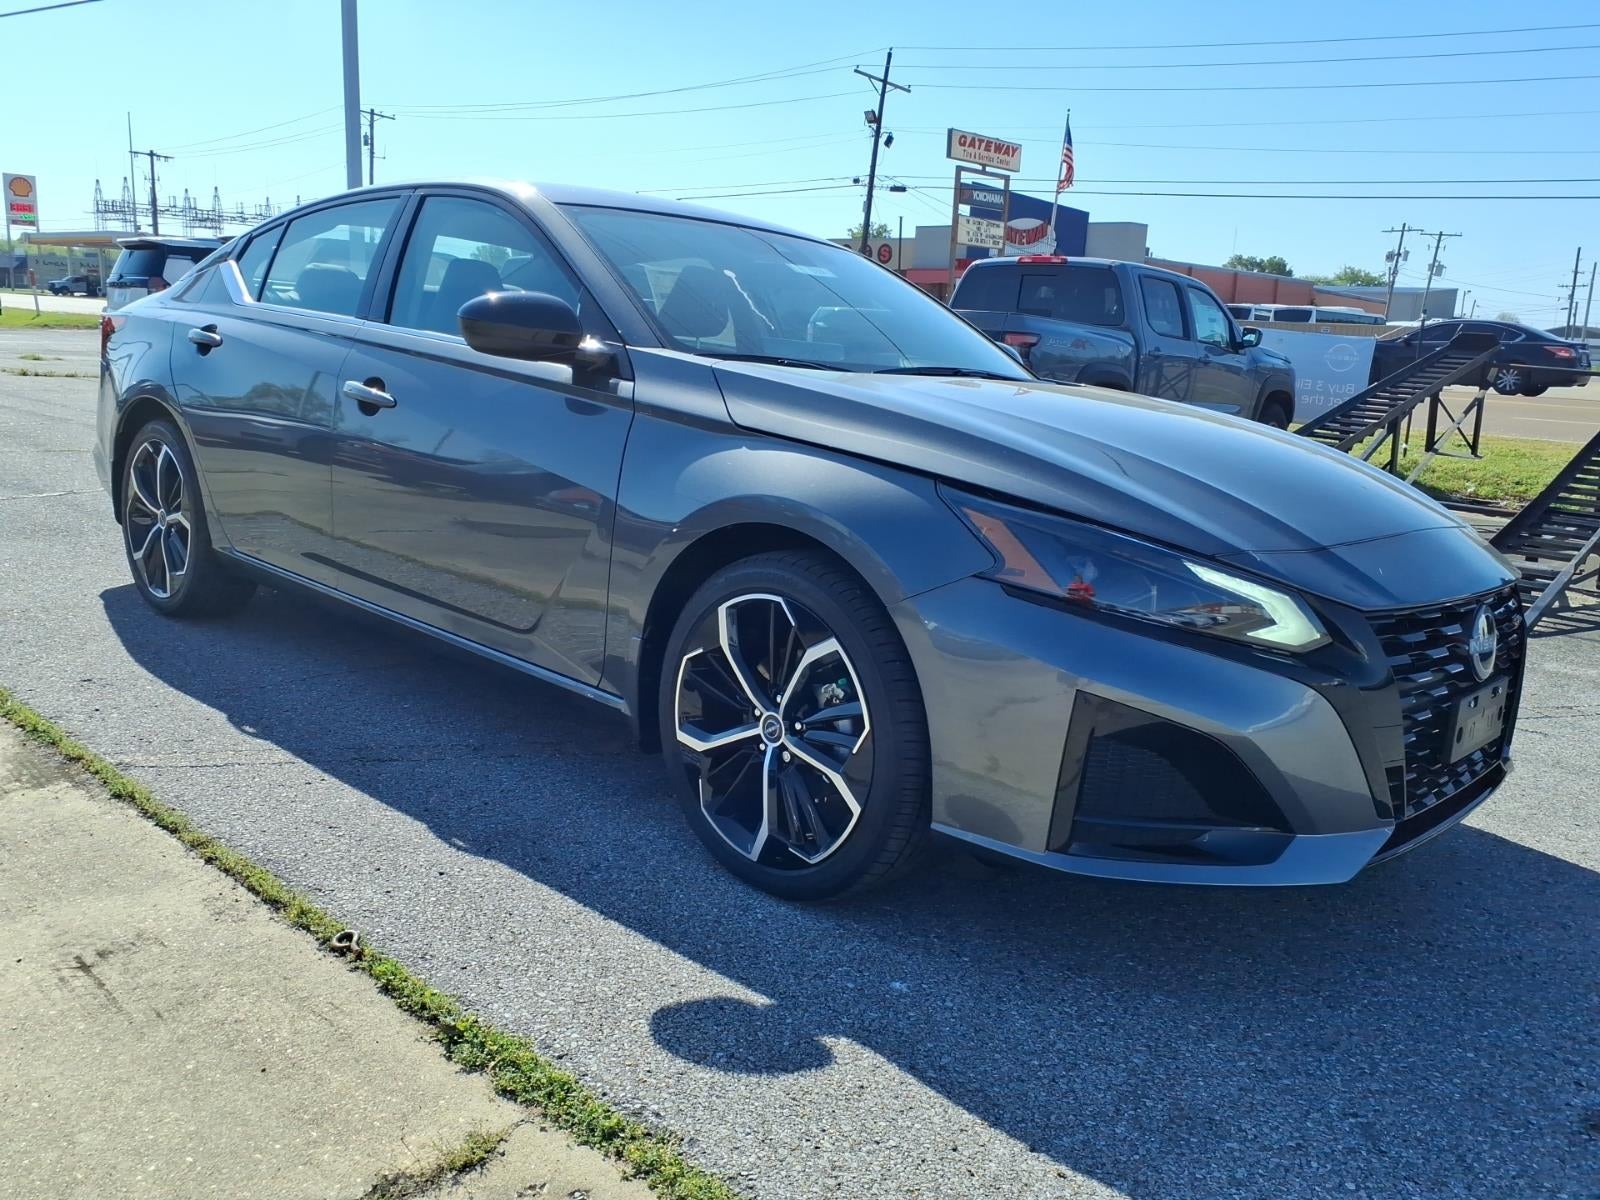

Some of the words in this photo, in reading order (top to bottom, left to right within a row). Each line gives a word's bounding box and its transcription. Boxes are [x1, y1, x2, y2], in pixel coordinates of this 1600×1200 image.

[958, 134, 1020, 158] GATEWAY
[962, 149, 972, 160] Tire
[978, 152, 995, 163] Service
[972, 190, 1004, 204] YOKOHAMA
